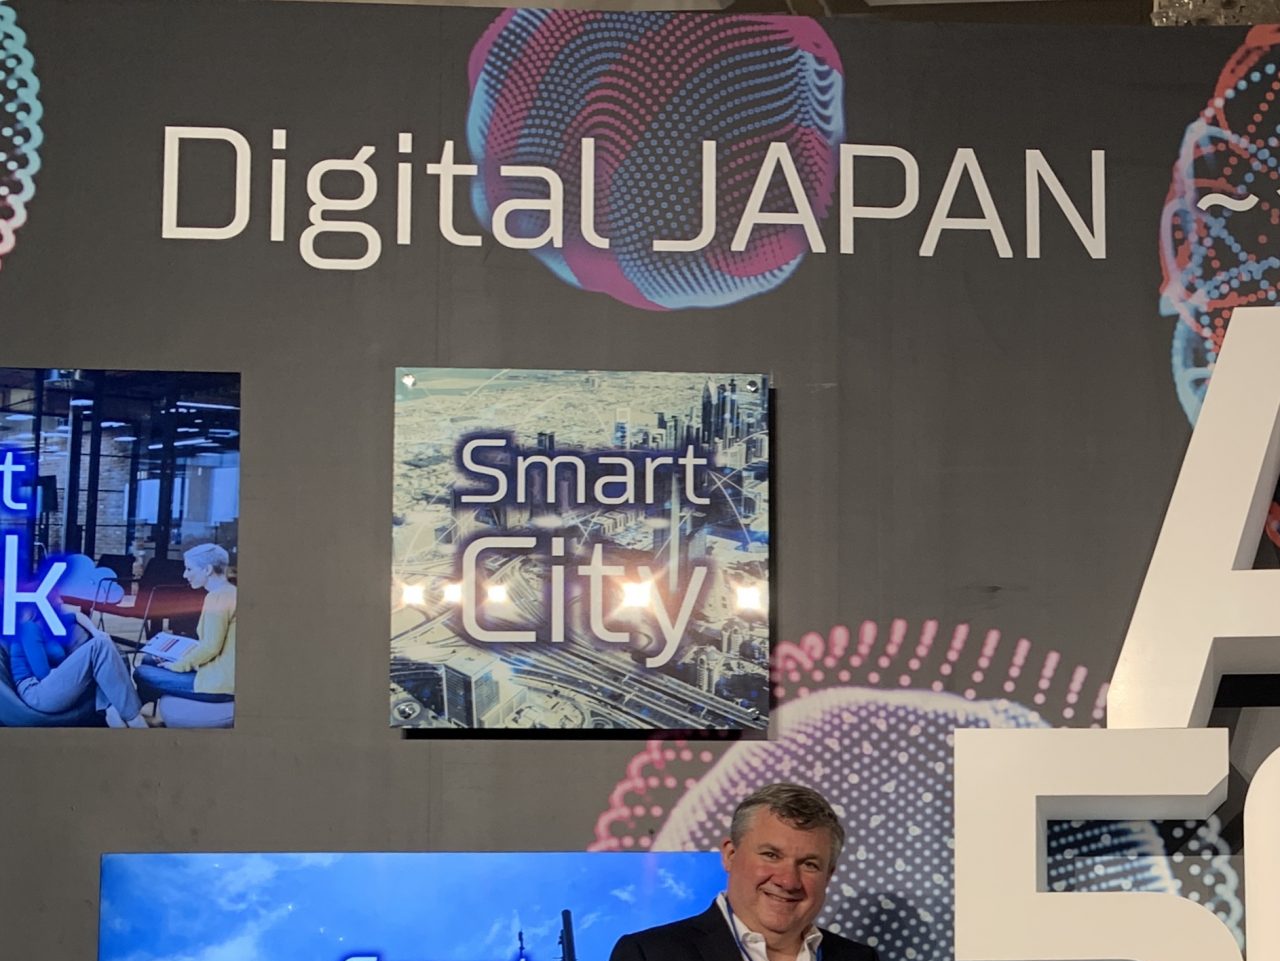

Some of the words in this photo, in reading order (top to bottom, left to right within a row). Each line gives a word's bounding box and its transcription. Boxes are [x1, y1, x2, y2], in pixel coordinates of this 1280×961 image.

[161, 125, 611, 271] Digital
[652, 139, 1107, 260] JAPAN
[460, 438, 711, 505] Smart
[461, 536, 708, 669] City
